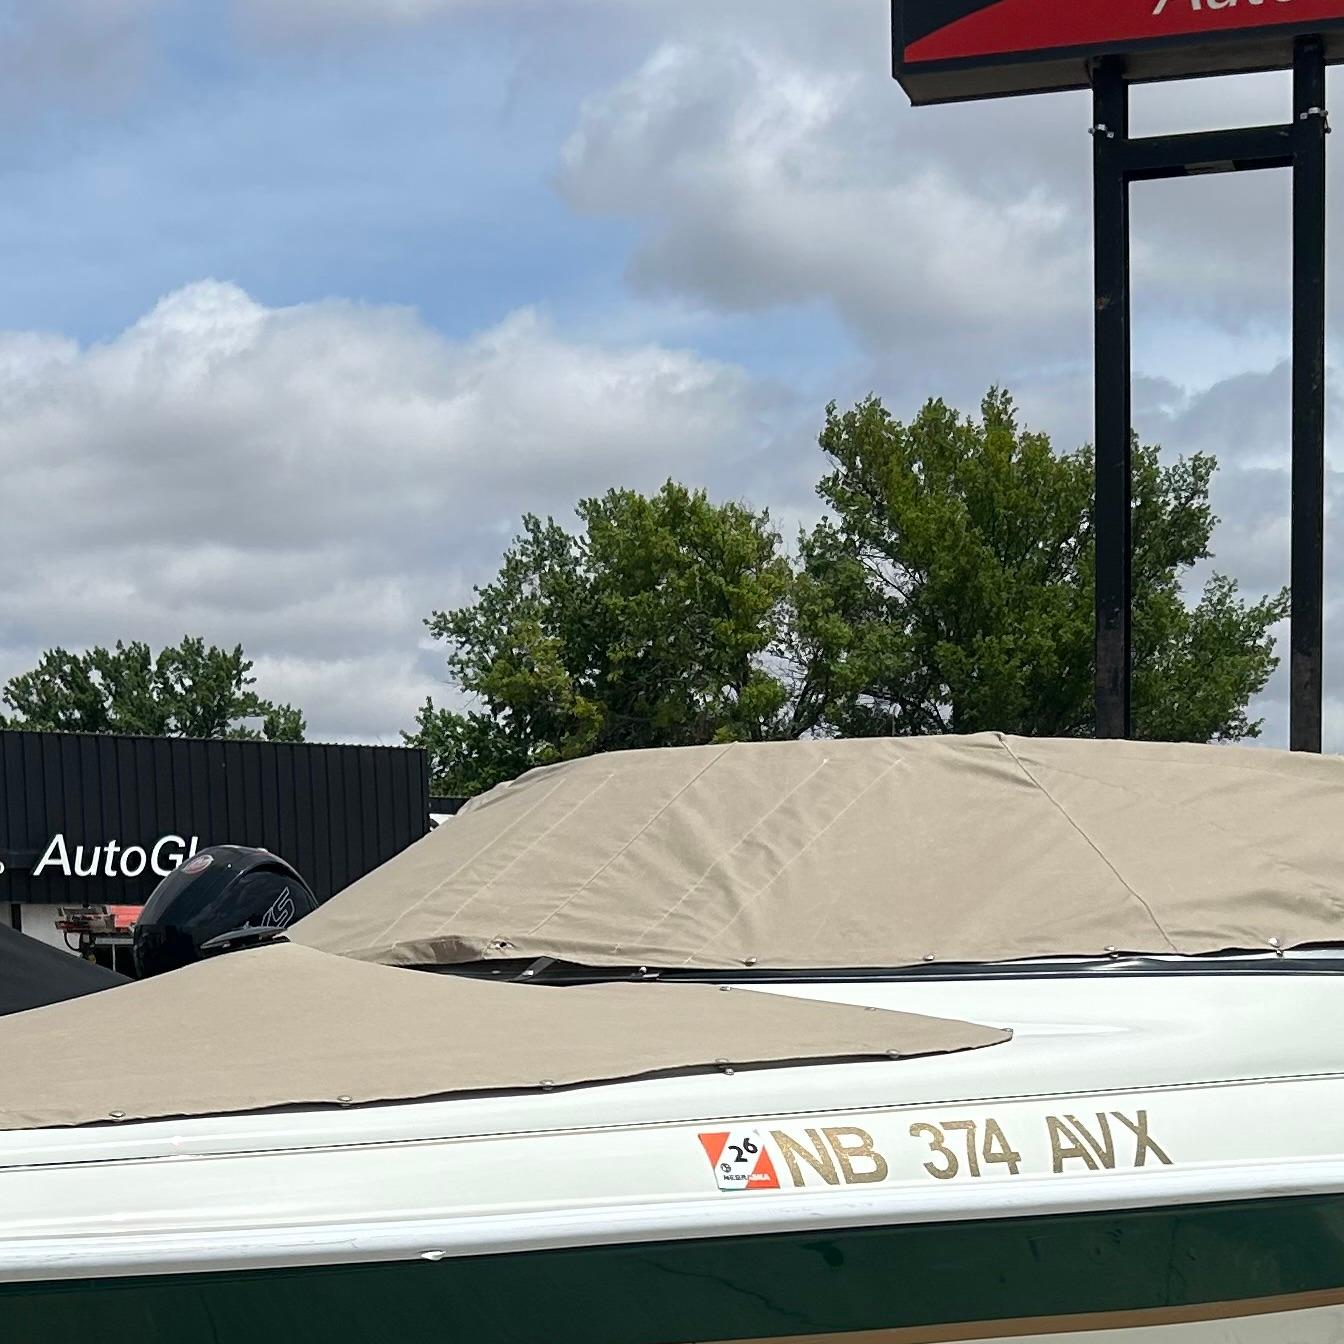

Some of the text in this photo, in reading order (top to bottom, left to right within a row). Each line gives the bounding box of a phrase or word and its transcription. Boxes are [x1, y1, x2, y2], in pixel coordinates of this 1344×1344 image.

[728, 1138, 758, 1162] 26
[770, 1110, 1174, 1188] NB 374 AVX
